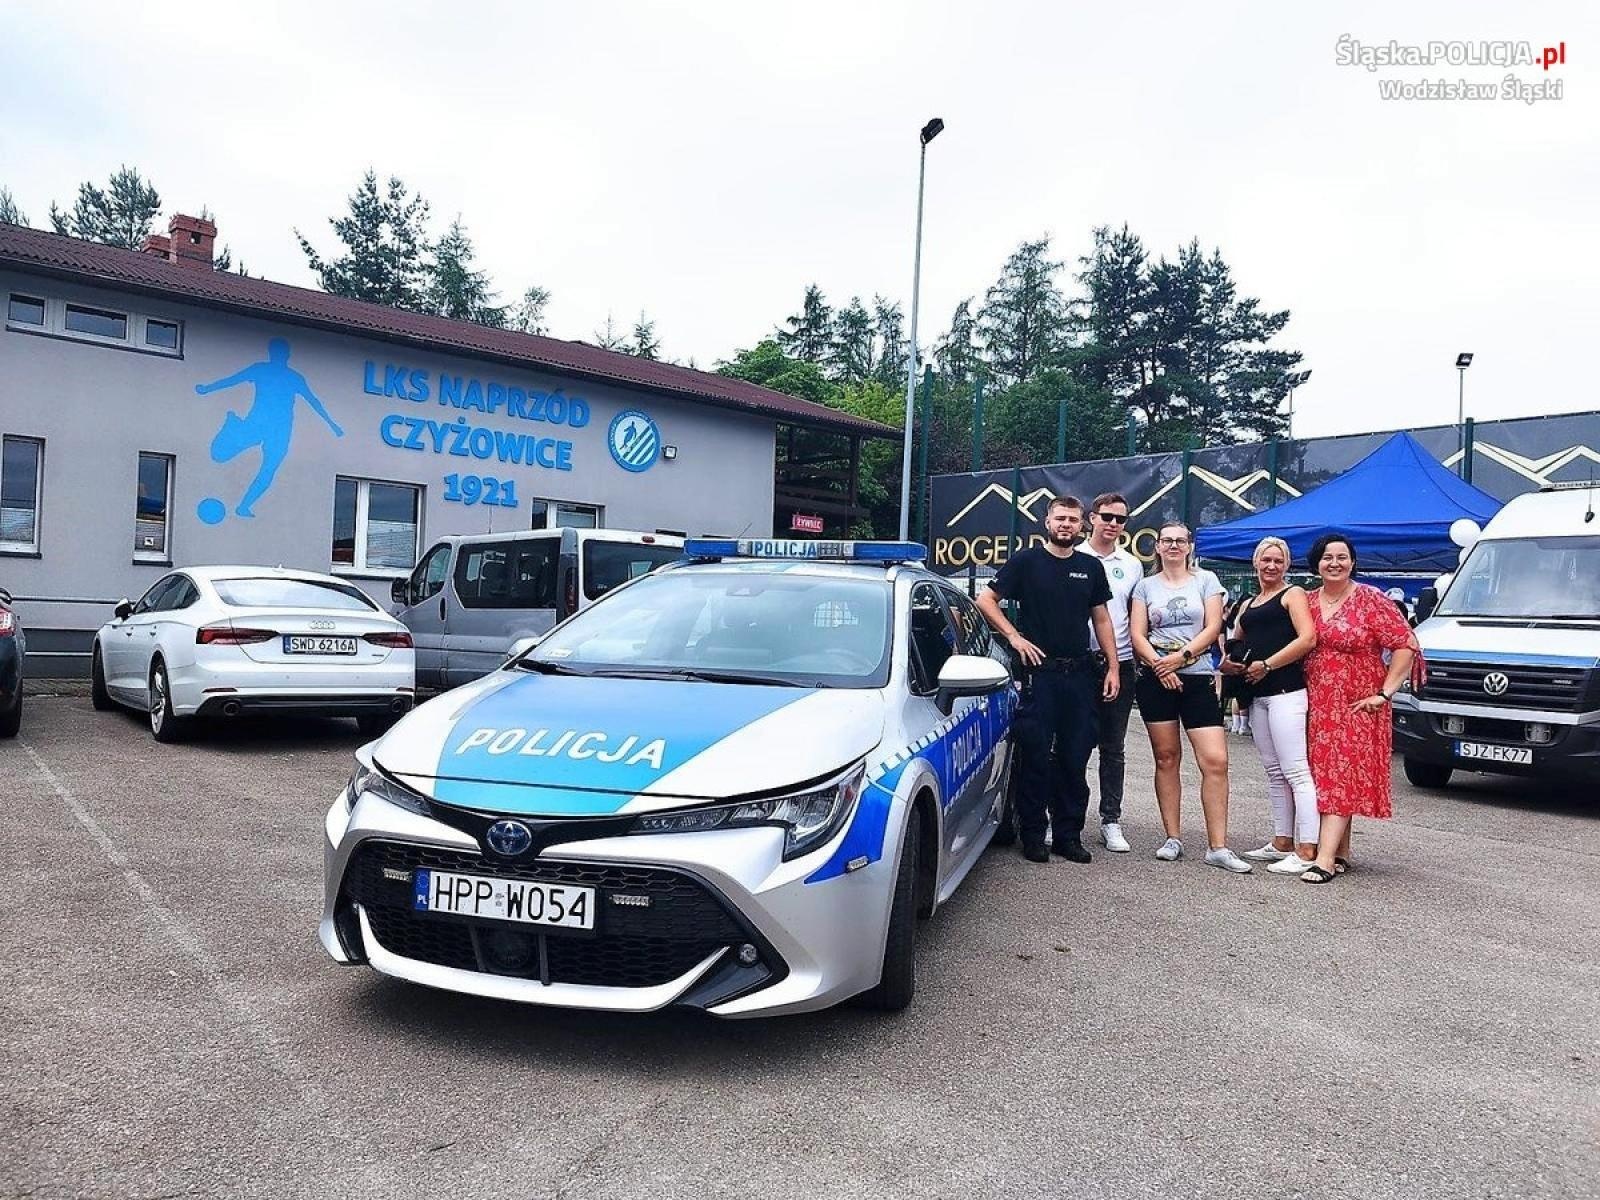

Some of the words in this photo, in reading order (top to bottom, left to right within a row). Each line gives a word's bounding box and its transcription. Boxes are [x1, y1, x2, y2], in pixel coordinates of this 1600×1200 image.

[363, 360, 430, 402] LKS
[439, 372, 591, 428] NAPRZÓD
[380, 414, 573, 471] CZYŻOWICE
[443, 473, 518, 508] 1921
[754, 541, 817, 557] POLICJA
[291, 638, 316, 651] SWD
[318, 639, 356, 652] 6216A
[455, 728, 667, 770] POLICJA
[1462, 743, 1489, 758] SJZ
[1492, 747, 1529, 762] FK77
[434, 875, 494, 914] HPP
